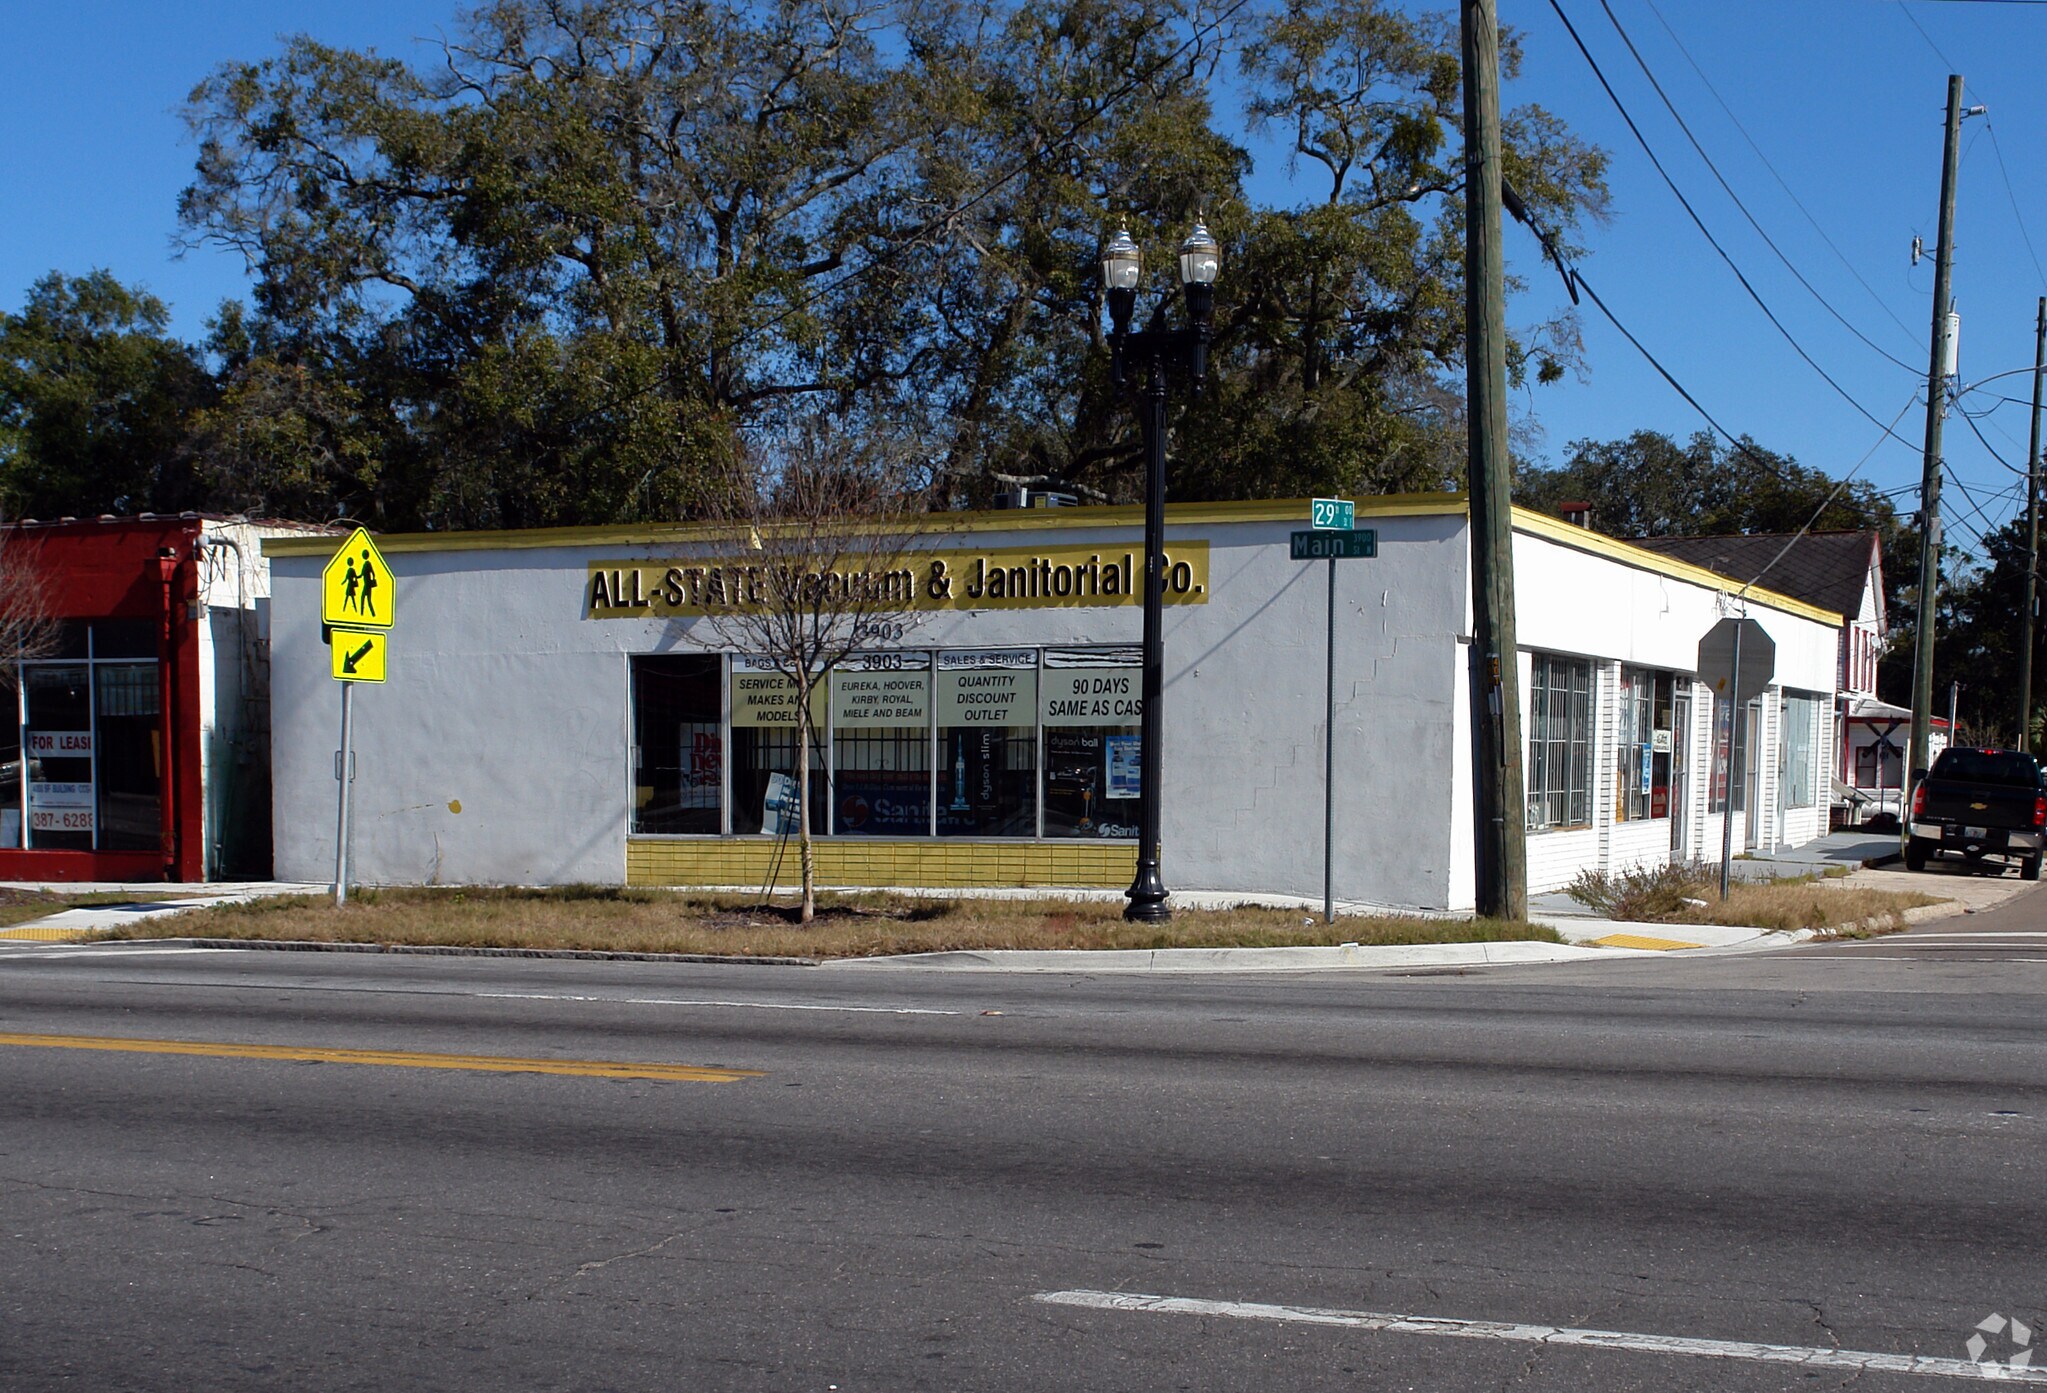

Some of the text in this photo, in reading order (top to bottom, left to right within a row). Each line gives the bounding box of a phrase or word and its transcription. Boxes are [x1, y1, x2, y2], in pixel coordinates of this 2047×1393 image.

[1353, 533, 1372, 543] 3900
[1293, 535, 1344, 555] Main
[590, 566, 767, 609] ALL-STATE
[927, 559, 953, 600] &
[967, 553, 1133, 599] Janitorial
[860, 622, 904, 641] 3903
[745, 658, 772, 668] BAGS
[862, 654, 902, 670] 3903
[943, 654, 1032, 665] SALES & SERVICE
[739, 679, 784, 690] SERVICE
[841, 681, 925, 691] EUREKA, HOOVER,
[958, 676, 1015, 688] QUANTITY
[1072, 677, 1130, 695] 90 DAYS
[747, 695, 784, 706] MAKES
[851, 695, 913, 705] KIRBY, ROYAL,
[957, 692, 1016, 704] DISCOUNT
[843, 708, 922, 718] MIELE AND BEAM
[1048, 699, 1142, 717] SAME AS CAS
[757, 711, 800, 722] MODELS
[964, 709, 1008, 721] OUTLET
[32, 735, 54, 750] FOR
[980, 733, 990, 760] slim
[1051, 736, 1080, 749] dyson
[1081, 737, 1099, 748] ball
[980, 764, 992, 800] dyson
[1110, 824, 1140, 837] Sanit
